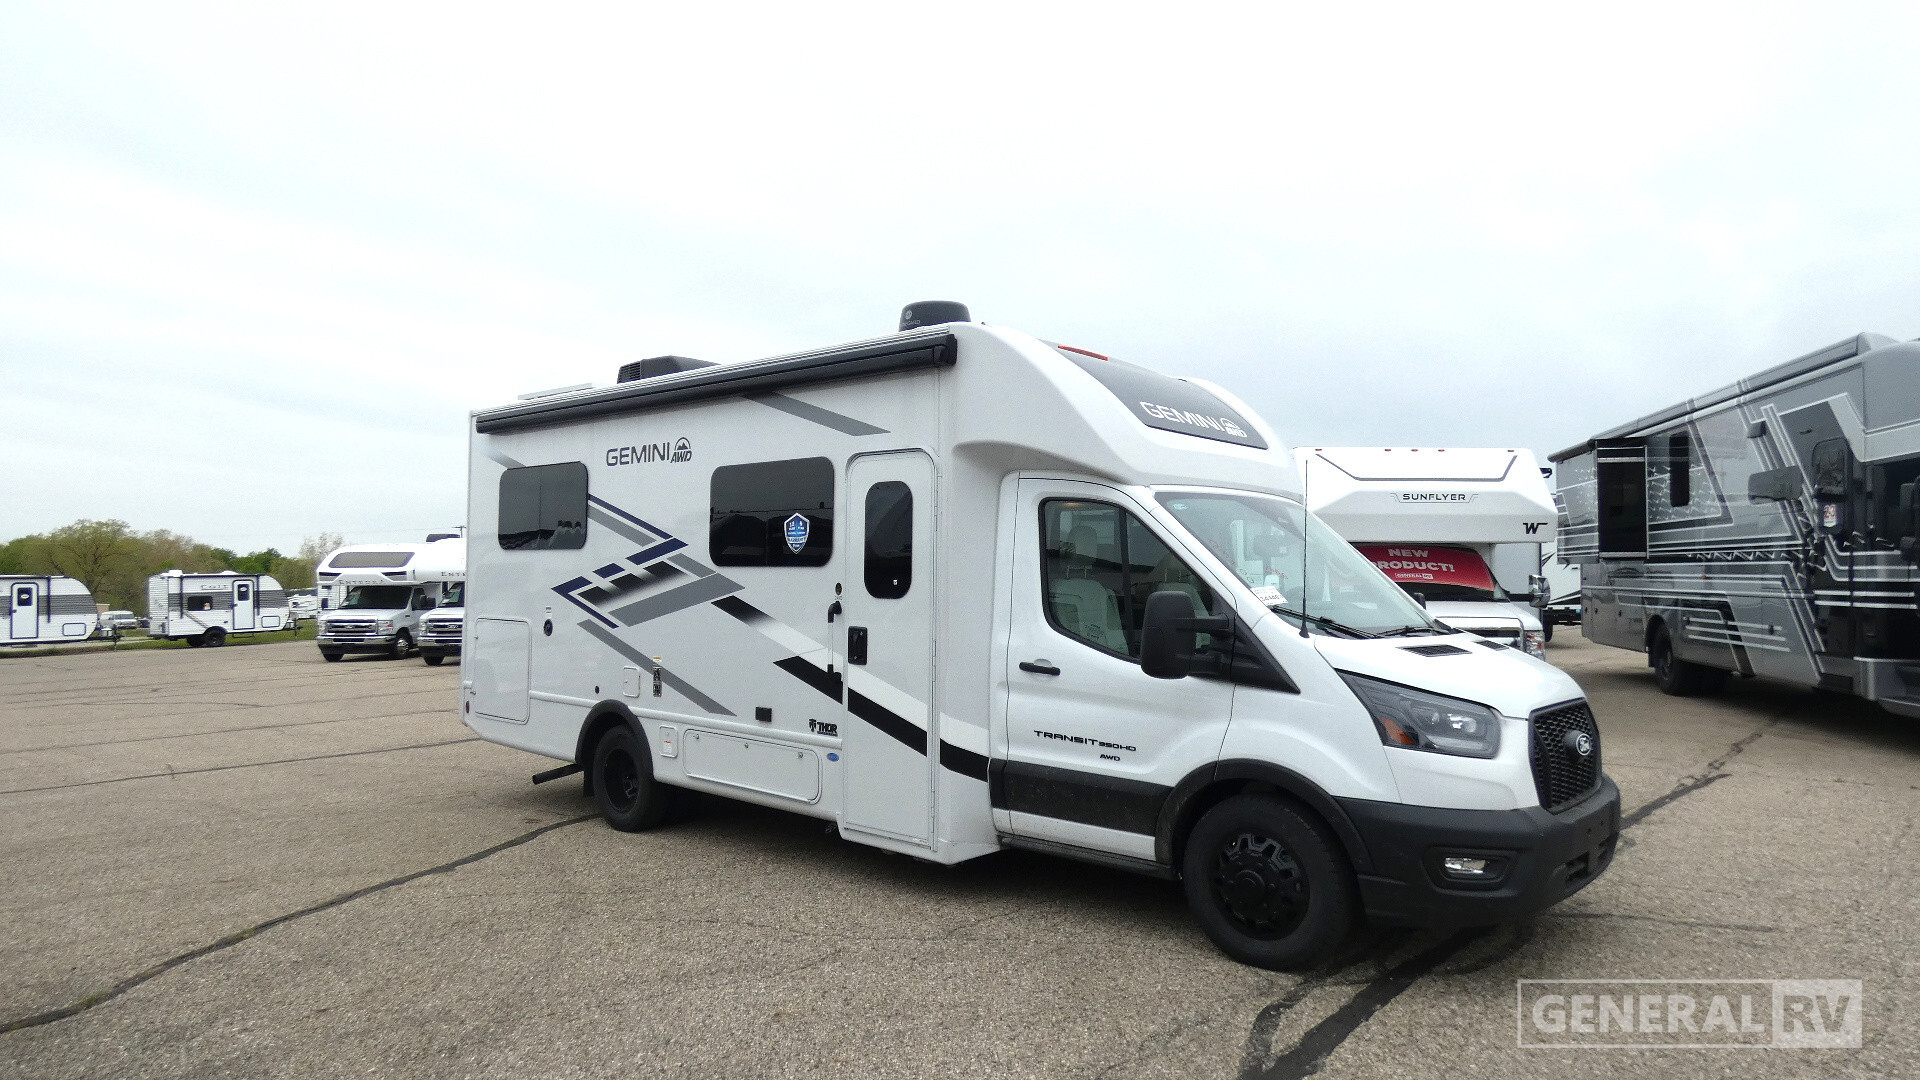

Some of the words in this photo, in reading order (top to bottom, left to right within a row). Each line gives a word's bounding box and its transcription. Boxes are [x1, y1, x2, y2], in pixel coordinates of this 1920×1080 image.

[1140, 401, 1225, 432] GEMINI
[606, 442, 670, 467] GEMINI
[670, 450, 692, 463] AWD
[1402, 493, 1466, 501] SUNFLYER
[1522, 522, 1548, 535] W
[1388, 548, 1429, 558] NEW
[816, 721, 838, 734] THOR
[1033, 729, 1099, 746] TRANSIT
[1099, 753, 1121, 762] AWD
